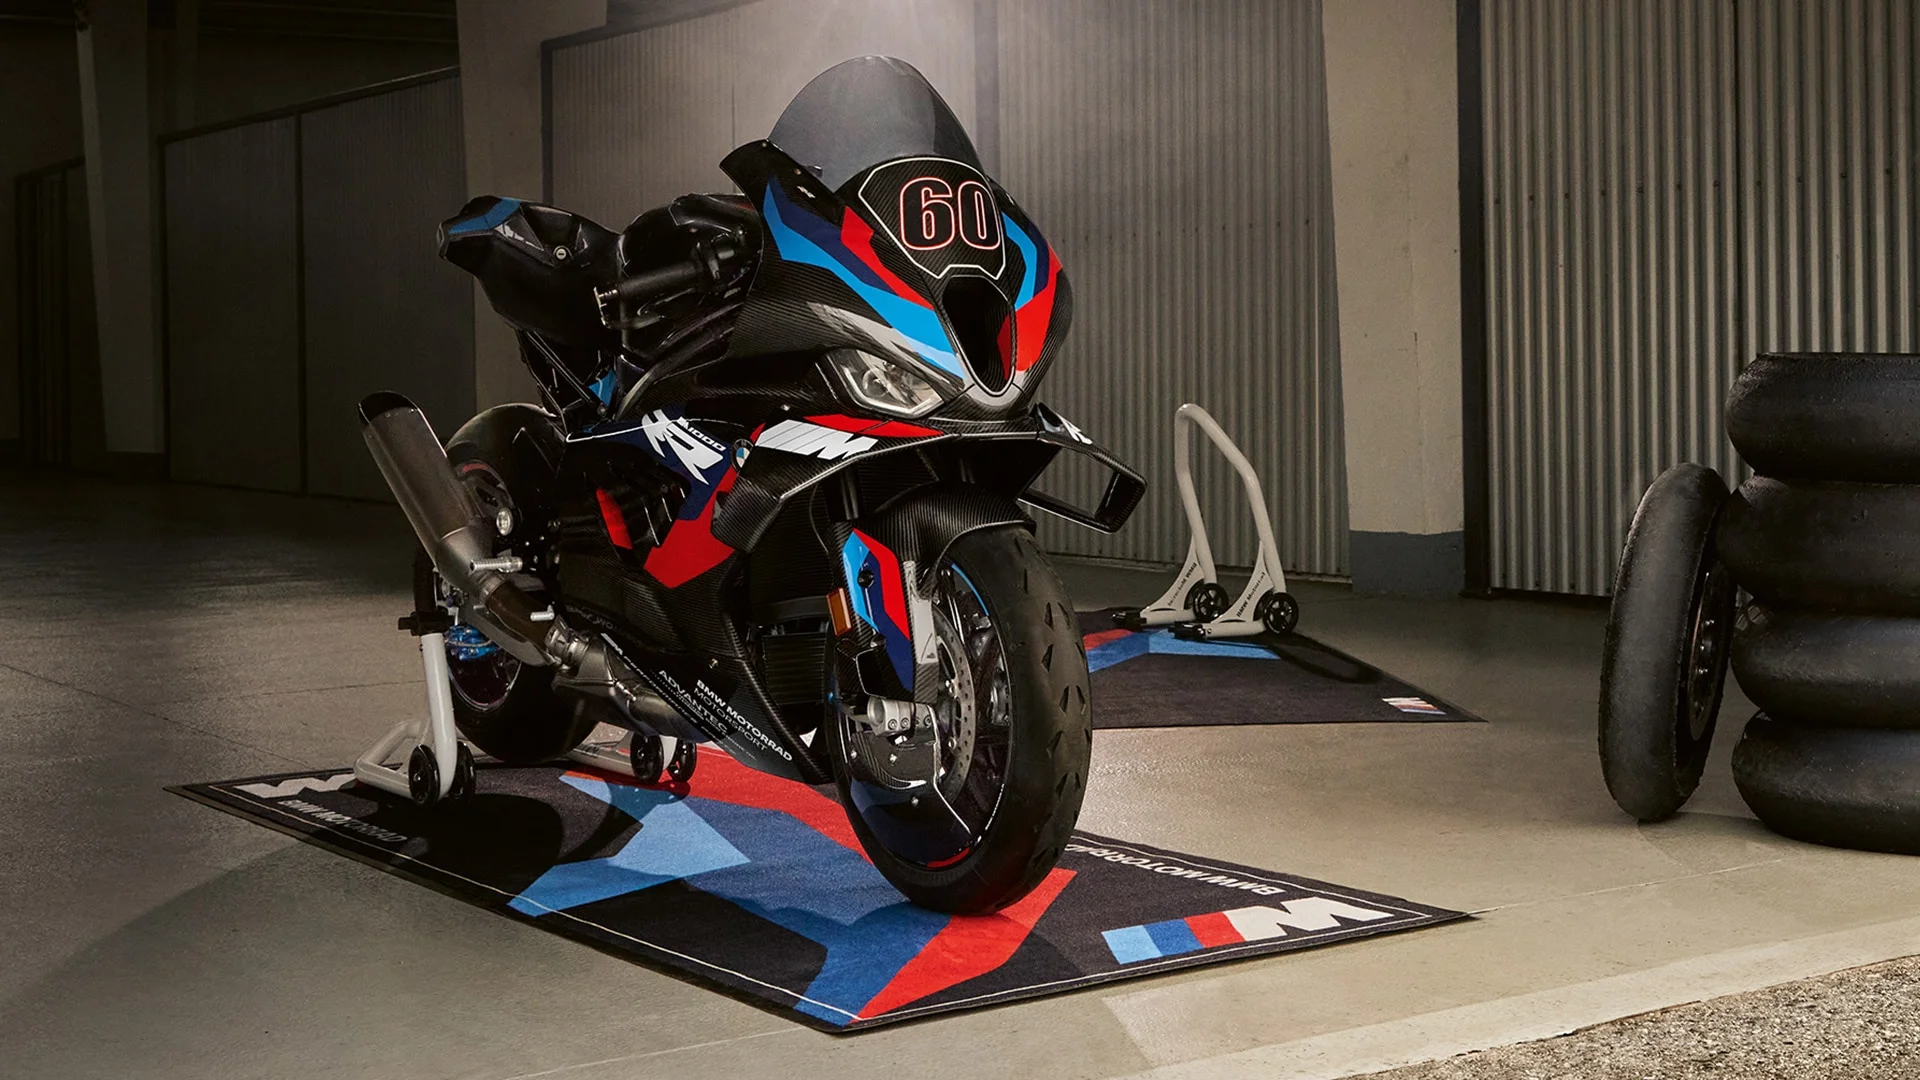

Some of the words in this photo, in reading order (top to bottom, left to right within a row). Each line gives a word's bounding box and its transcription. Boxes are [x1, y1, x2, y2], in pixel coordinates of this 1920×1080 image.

[900, 177, 1000, 250] 60
[658, 669, 728, 734] ADVANTEC
[694, 687, 768, 751] MOTORSPORT
[696, 679, 726, 708] BMW
[726, 706, 793, 762] MOTORRAD
